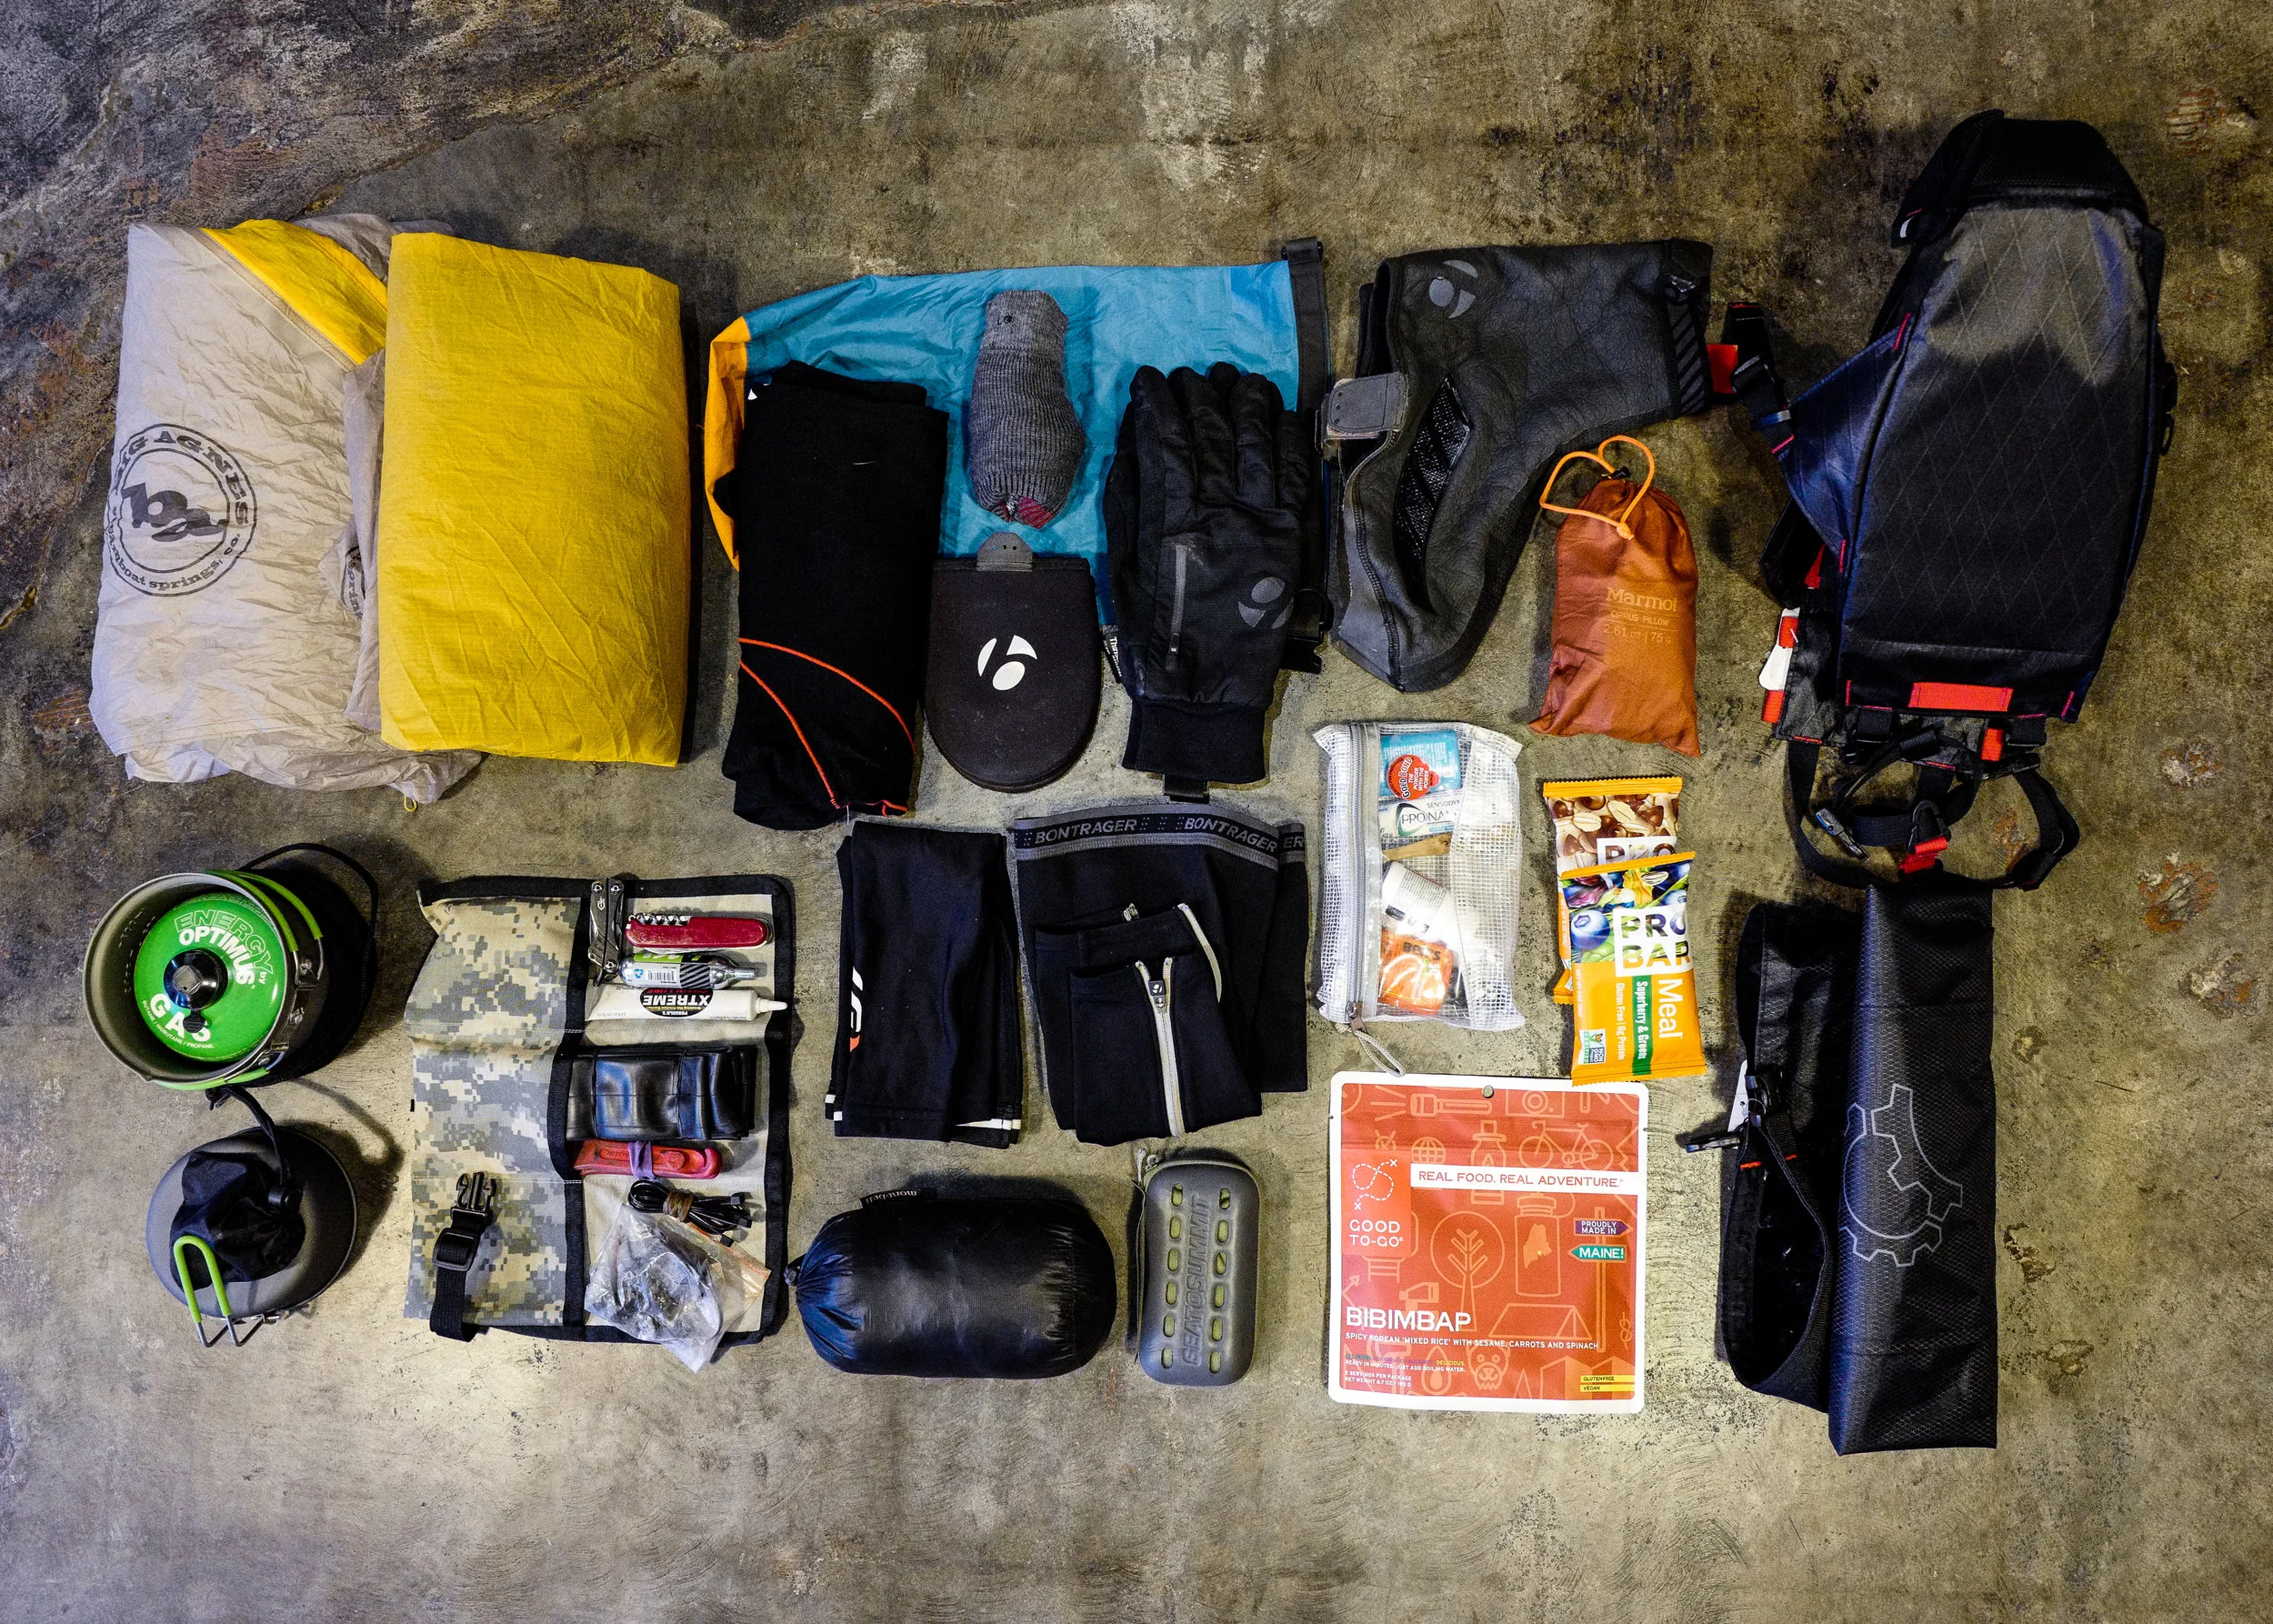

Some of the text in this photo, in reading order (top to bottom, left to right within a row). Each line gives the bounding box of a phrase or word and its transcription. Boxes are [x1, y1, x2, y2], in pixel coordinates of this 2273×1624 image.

[153, 430, 249, 526] AGNES
[1606, 586, 1678, 612] Marmot
[1610, 610, 1669, 627] CIRRUS PILLOW
[1603, 624, 1628, 637] 2.61
[1651, 631, 1664, 643] 75
[1398, 757, 1413, 798] GOLD BOND
[1035, 817, 1278, 854] BONTRAGER BONTRAGER
[1620, 912, 1687, 939] PRO
[174, 909, 274, 985] ENERGY by
[178, 926, 255, 985] OPTIMUS
[1622, 939, 1691, 969] BAR
[642, 994, 711, 1007] XTREME
[1615, 982, 1625, 1006] Gluten
[1617, 1006, 1626, 1022] Free
[1634, 981, 1649, 1059] Superberry & Greens
[1657, 978, 1684, 1038] Meal
[142, 1000, 155, 1022] BUTANE
[156, 1023, 183, 1045] ISOBUTANE
[1616, 1026, 1627, 1037] 8g
[1617, 1036, 1627, 1061] Protein
[1418, 1170, 1453, 1182] REAL
[1457, 1172, 1497, 1184] FOOD.
[1499, 1174, 1534, 1185] REAL
[1349, 1218, 1400, 1234] GOOD
[1581, 1220, 1617, 1228] PROUDLY
[1578, 1247, 1625, 1258] MAINE!
[1346, 1306, 1472, 1332] BIBIMBAP
[1345, 1332, 1367, 1341] SPICY
[1369, 1334, 1400, 1343] KOREAN
[1474, 1339, 1508, 1348] SESAME,
[1509, 1340, 1546, 1348] CARROTS
[1566, 1341, 1598, 1349] SPINACH
